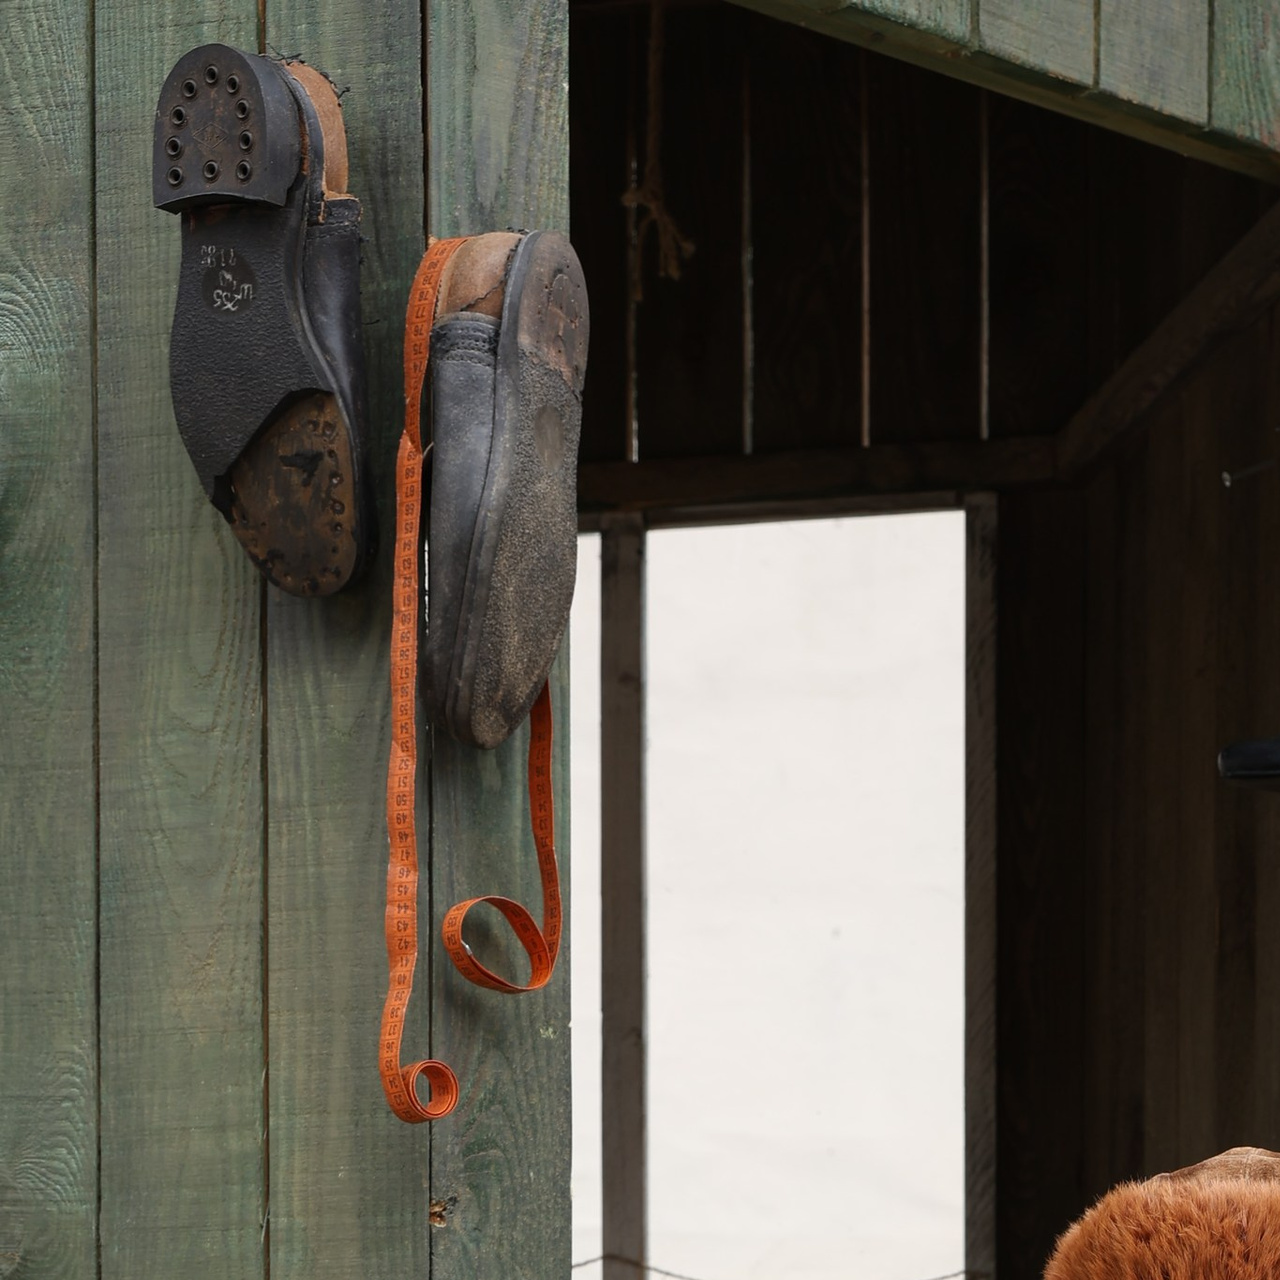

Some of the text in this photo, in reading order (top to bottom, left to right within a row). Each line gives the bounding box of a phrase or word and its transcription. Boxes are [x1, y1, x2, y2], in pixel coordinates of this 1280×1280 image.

[415, 306, 426, 319] 77
[413, 342, 423, 356] 75
[404, 484, 416, 499] 67
[398, 666, 410, 681] 57
[400, 703, 409, 717] 55
[400, 721, 410, 735] 54
[398, 758, 410, 772] 52
[398, 776, 409, 789] 51
[395, 793, 408, 807] 50
[396, 812, 408, 825] 49
[398, 831, 410, 843] 48
[400, 849, 411, 862] 47
[399, 867, 411, 879] 46
[397, 884, 409, 897] 45
[397, 902, 410, 915] 44
[396, 920, 409, 933] 43
[397, 938, 410, 951] 42
[400, 955, 411, 968] 41
[397, 973, 408, 986] 40
[393, 990, 406, 1002] 39
[390, 1006, 402, 1019] 38
[388, 1024, 399, 1037] 37
[385, 1041, 396, 1054] 36
[385, 1058, 395, 1072] 35
[388, 1076, 400, 1090] 34
